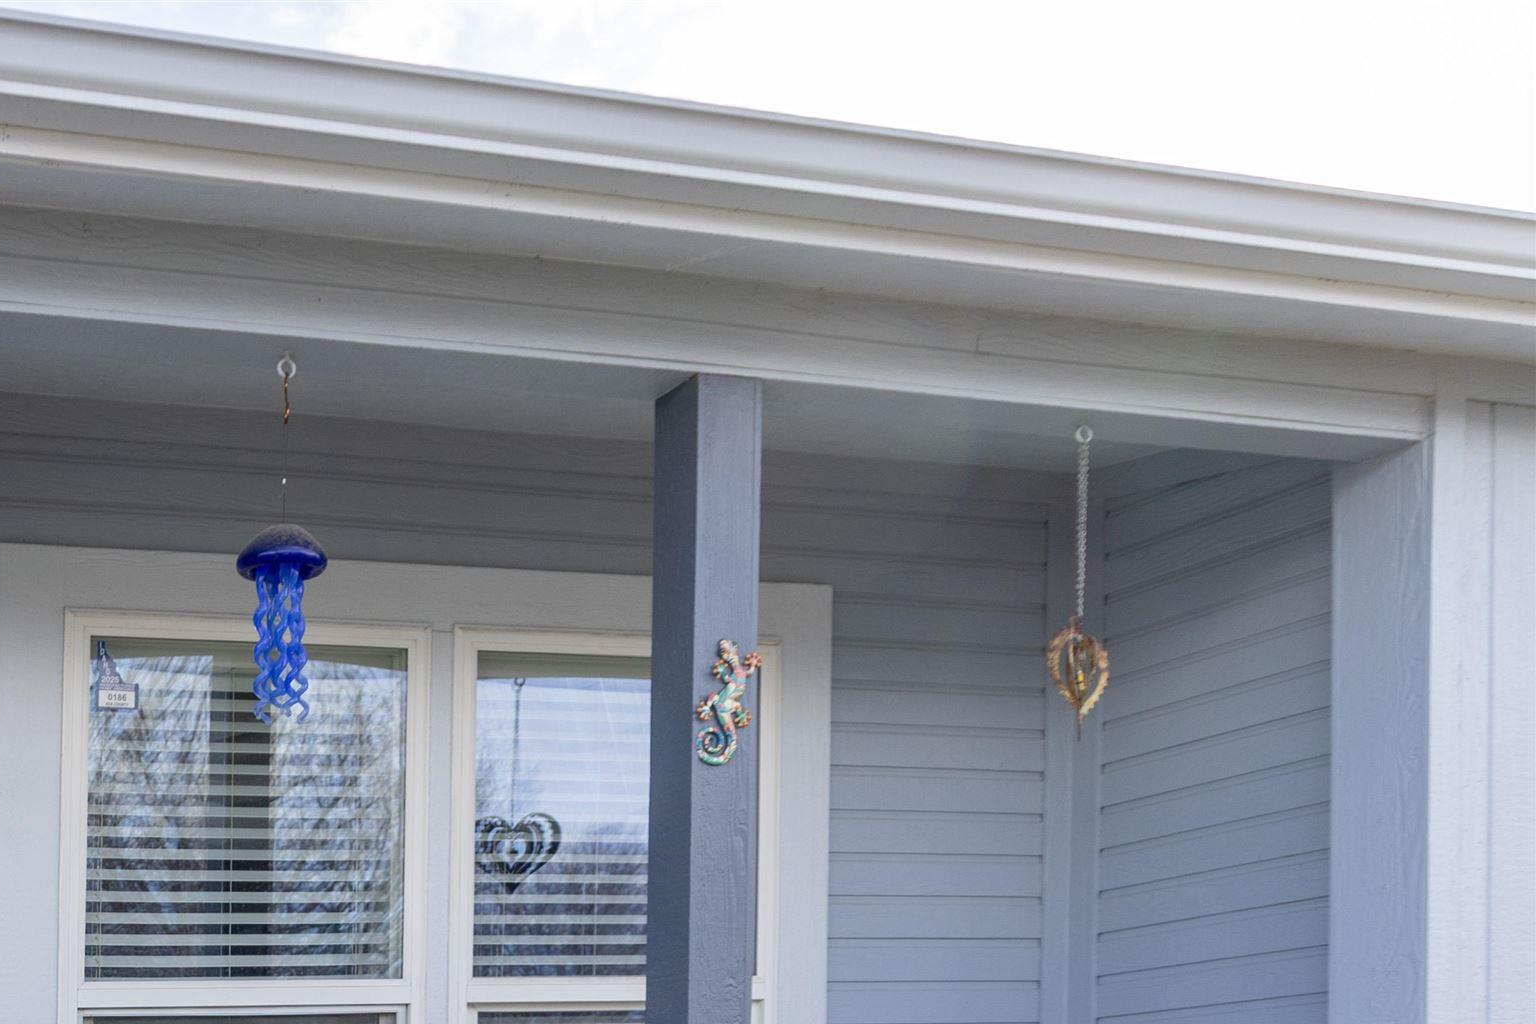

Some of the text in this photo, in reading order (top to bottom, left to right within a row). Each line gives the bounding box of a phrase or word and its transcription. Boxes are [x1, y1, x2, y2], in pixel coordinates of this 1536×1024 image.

[99, 640, 111, 675] IDAHO
[101, 675, 120, 684] 2025
[107, 693, 128, 702] 0186
